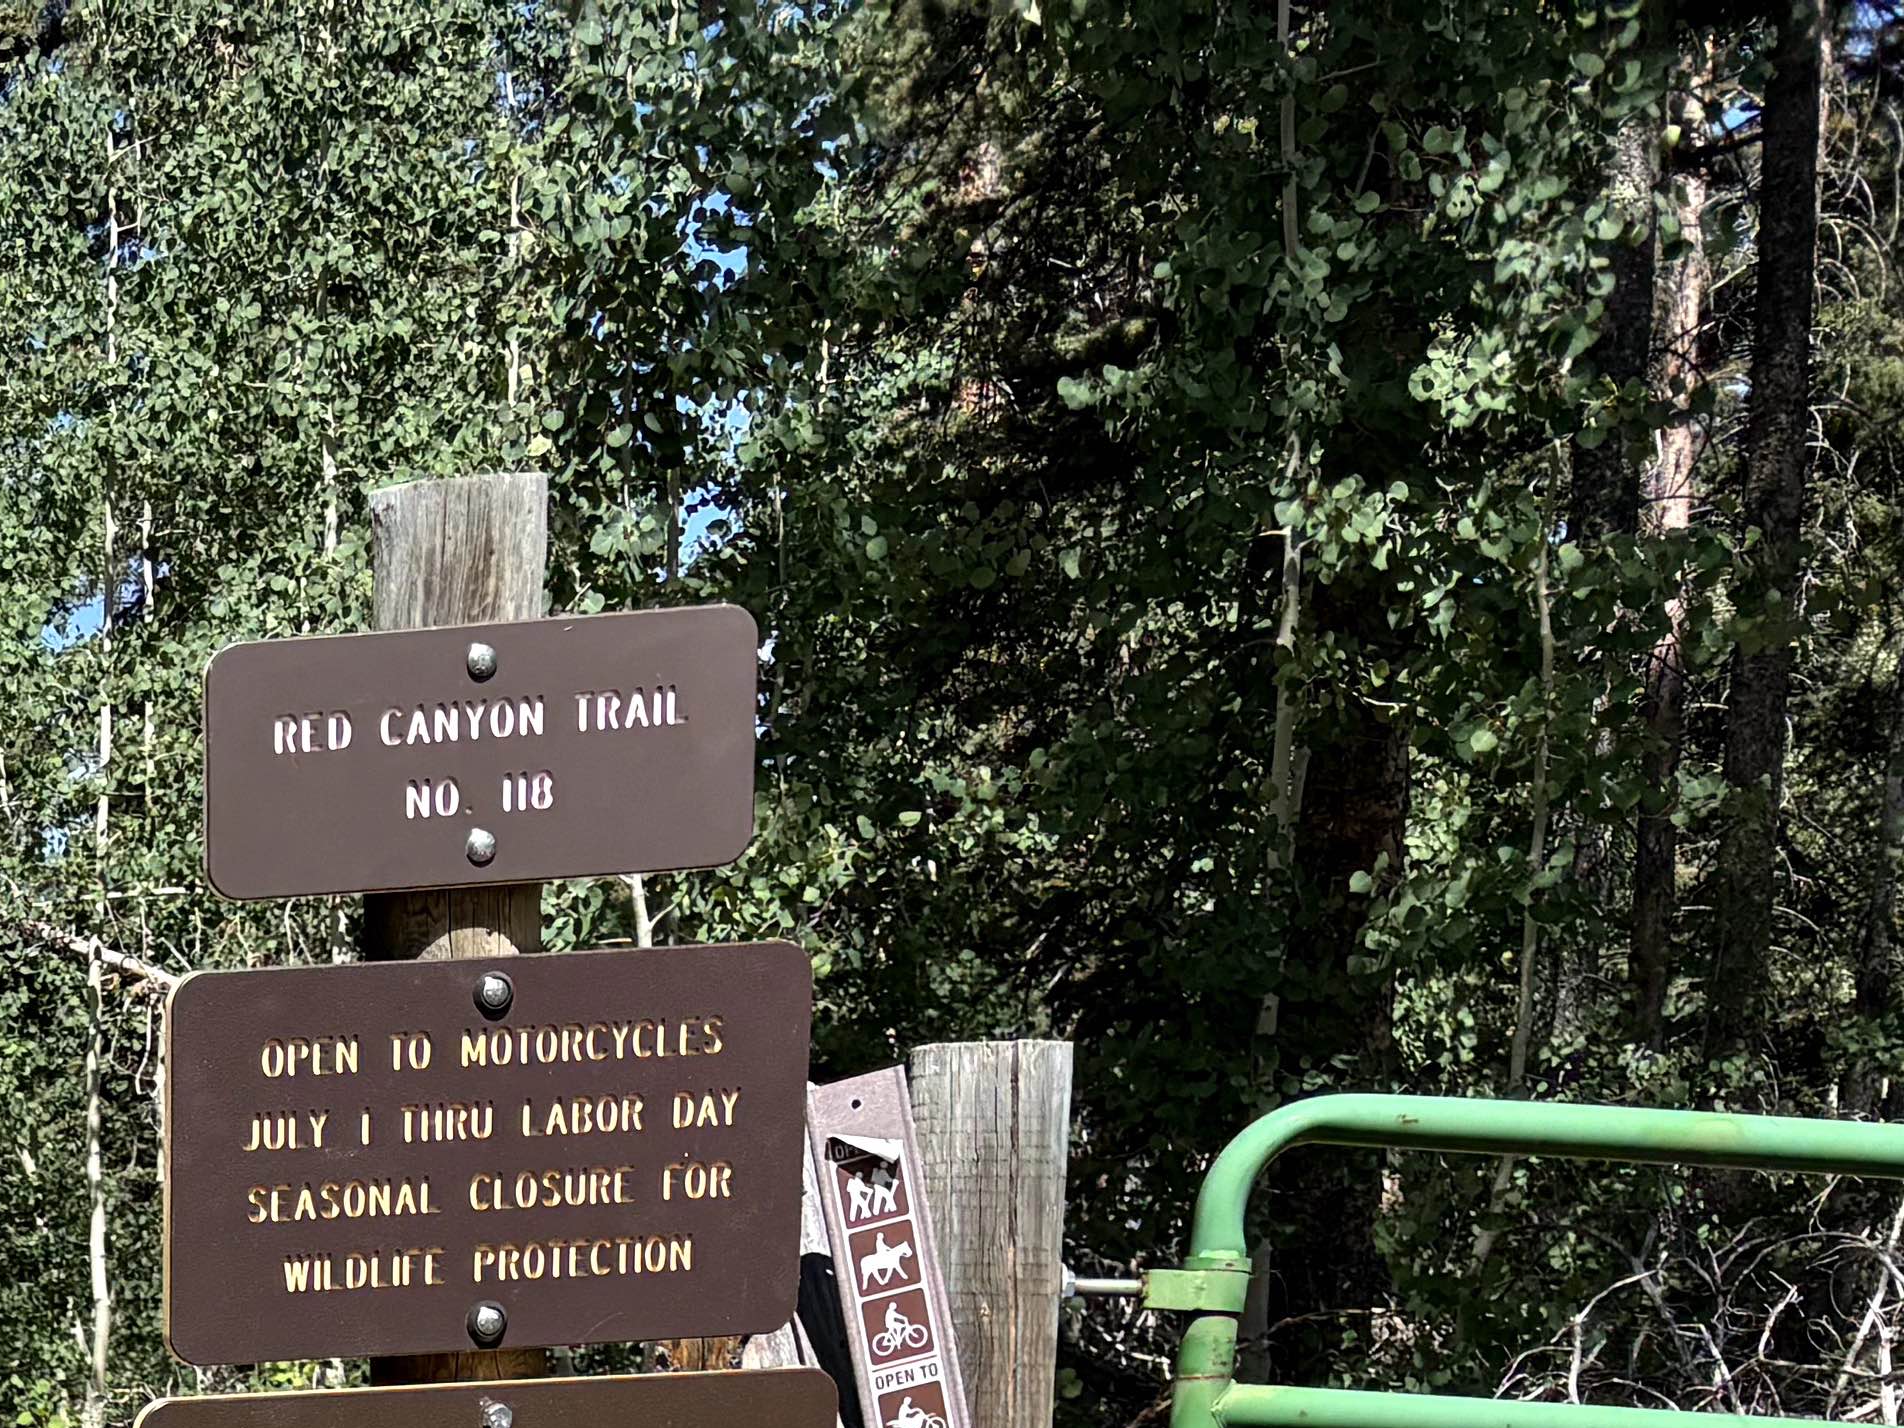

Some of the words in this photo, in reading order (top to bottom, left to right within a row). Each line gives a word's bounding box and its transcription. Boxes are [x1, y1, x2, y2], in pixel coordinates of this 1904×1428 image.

[273, 712, 353, 755] RED
[379, 695, 545, 748] CANYON
[574, 684, 690, 732] TRAIL
[405, 776, 473, 820] NO.
[502, 769, 553, 812] 118
[261, 1033, 359, 1078] OPEN
[390, 1030, 432, 1071] TO
[460, 1014, 724, 1068] MOTORCYCLES
[242, 1108, 330, 1151] JULY
[401, 1099, 494, 1144] THRU
[522, 1092, 643, 1137] LABOR
[672, 1086, 742, 1129] DAY
[247, 1175, 442, 1224] SEASONAL
[468, 1165, 636, 1211] CLOSURE
[662, 1159, 733, 1201] FOR
[283, 1247, 445, 1293] WILDLIFE
[473, 1232, 694, 1283] PROTECTION
[875, 1368, 915, 1390] OPEN
[920, 1362, 939, 1378] TO
